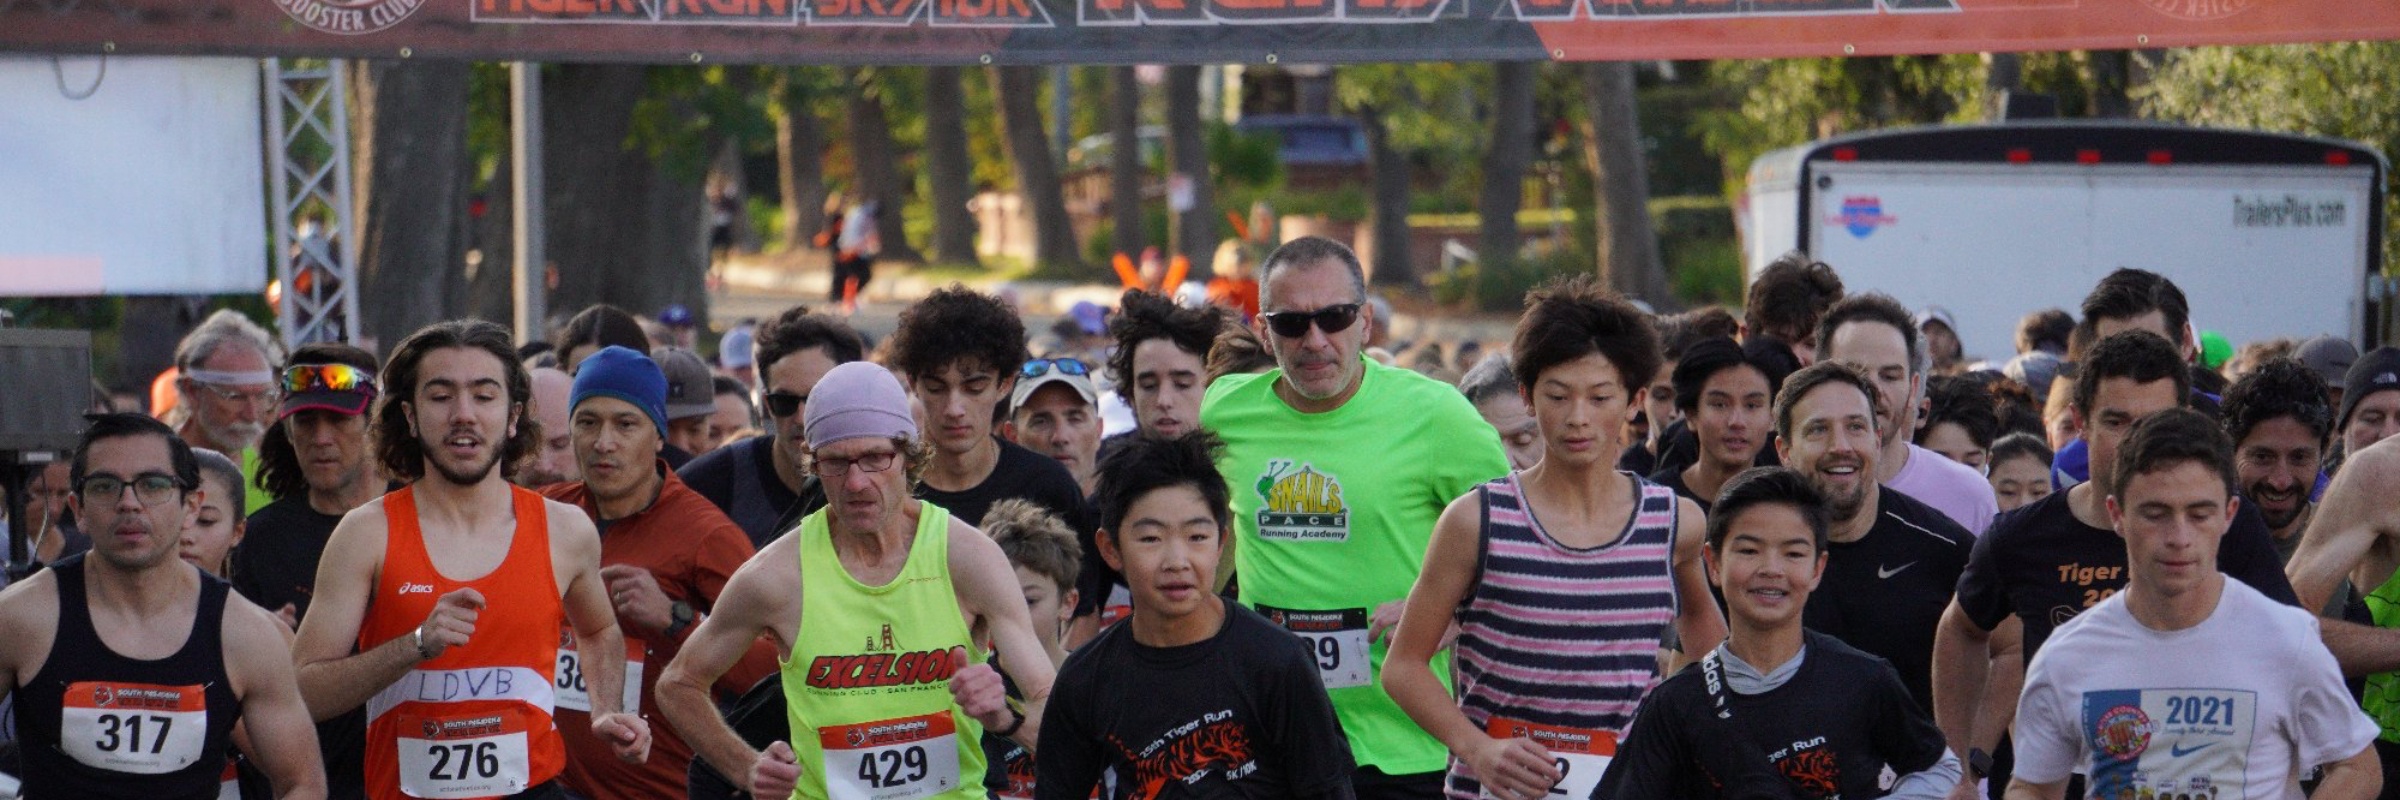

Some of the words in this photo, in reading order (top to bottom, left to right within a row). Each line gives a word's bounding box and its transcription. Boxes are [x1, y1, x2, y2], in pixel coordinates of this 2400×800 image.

[1268, 471, 1342, 513] SNAIL'S
[1260, 516, 1345, 526] PACE
[1260, 529, 1298, 539] Running
[1301, 530, 1346, 539] Academy
[2057, 562, 2122, 586] Tiger
[887, 687, 908, 695] SAN
[1163, 718, 1201, 741] Tiger
[1203, 708, 1233, 725] Run
[2165, 695, 2235, 726] 2021
[96, 714, 172, 755] 317
[1792, 735, 1826, 752] Run
[428, 741, 499, 781] 276
[858, 745, 928, 788] 429
